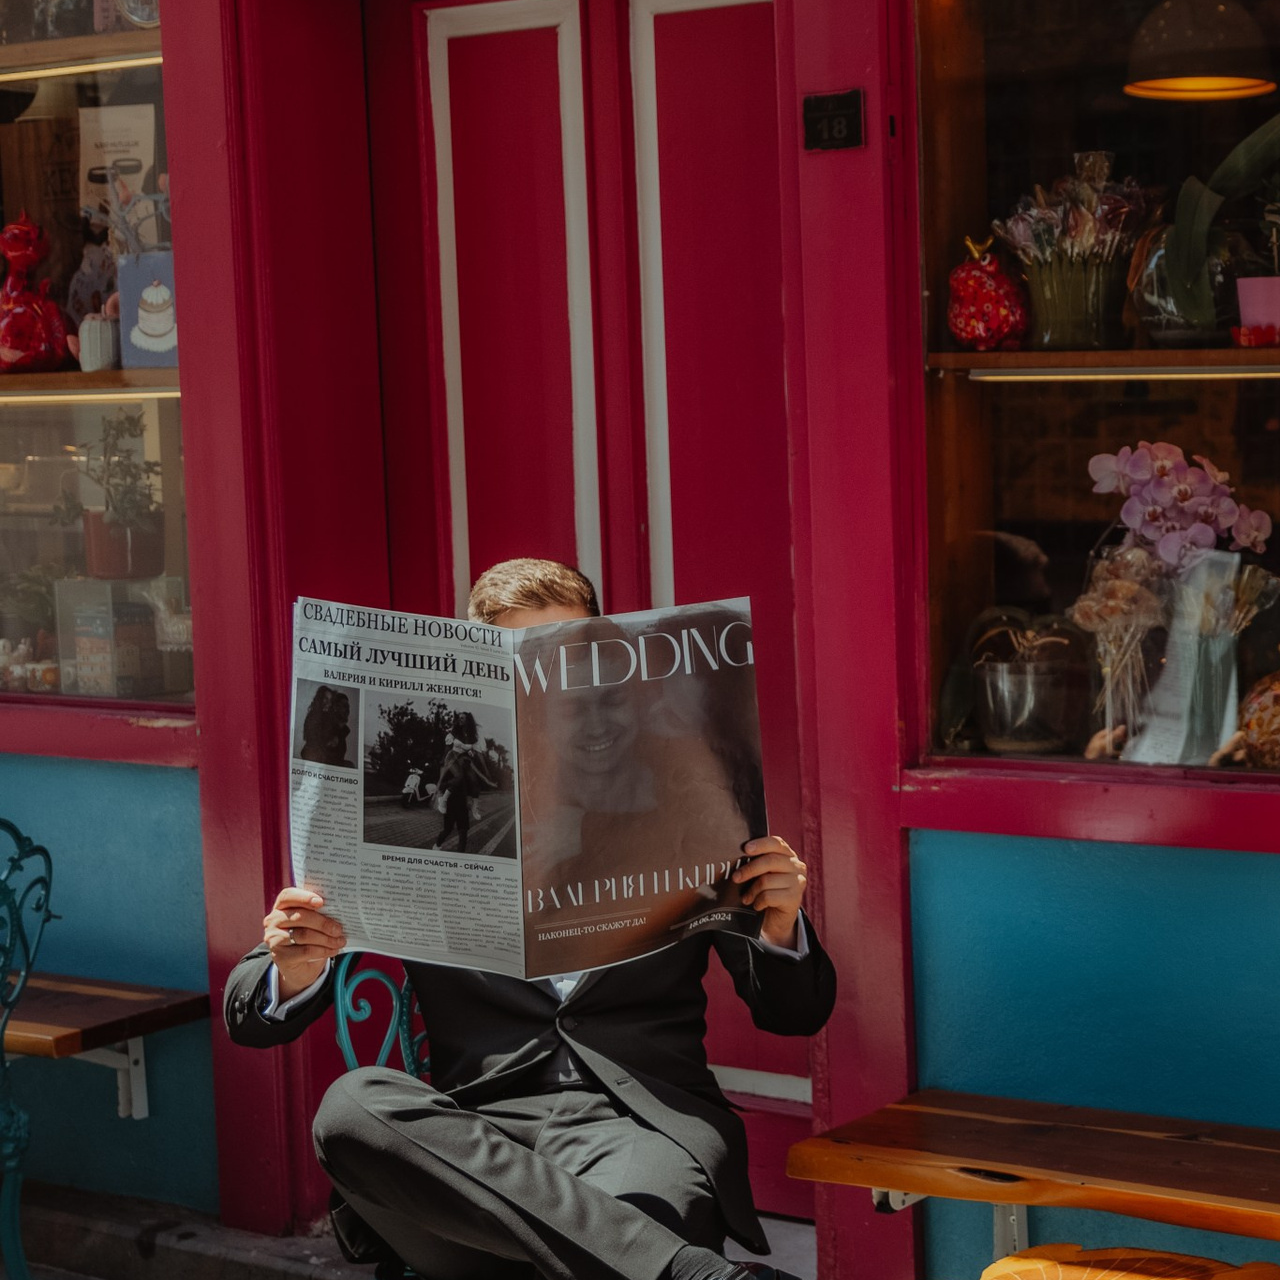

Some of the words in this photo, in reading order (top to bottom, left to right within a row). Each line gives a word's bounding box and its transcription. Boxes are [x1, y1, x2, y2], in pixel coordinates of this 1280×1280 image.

[816, 116, 848, 140] 18
[303, 602, 409, 635] СВАДЕБНЫЕ
[413, 620, 503, 648] НОВОСТИ
[298, 636, 362, 662] САМЫЙ
[365, 647, 458, 674] ЛУЧШИЙ
[462, 659, 511, 682] ДЕНЬ
[513, 621, 755, 697] WEDDING
[323, 669, 366, 685] ВАЛЕРИЯ
[368, 677, 376, 686] И
[378, 677, 425, 692] КИРИЛЛ
[426, 683, 482, 699] ЖЕНЯТСЯ!
[318, 773, 359, 785] СЧАСТЛИВО
[381, 854, 406, 863] ВРЕМЯ
[407, 857, 423, 866] ДЛЯ
[424, 859, 458, 869] СЧАСТЬЯ
[464, 862, 495, 872] СЕЙЧАС
[538, 925, 596, 941] НАКОНЕЦ-ТО
[598, 920, 632, 933] СКАЖУТ
[632, 917, 647, 927] ДА!
[688, 912, 732, 930] 18.06.2024
